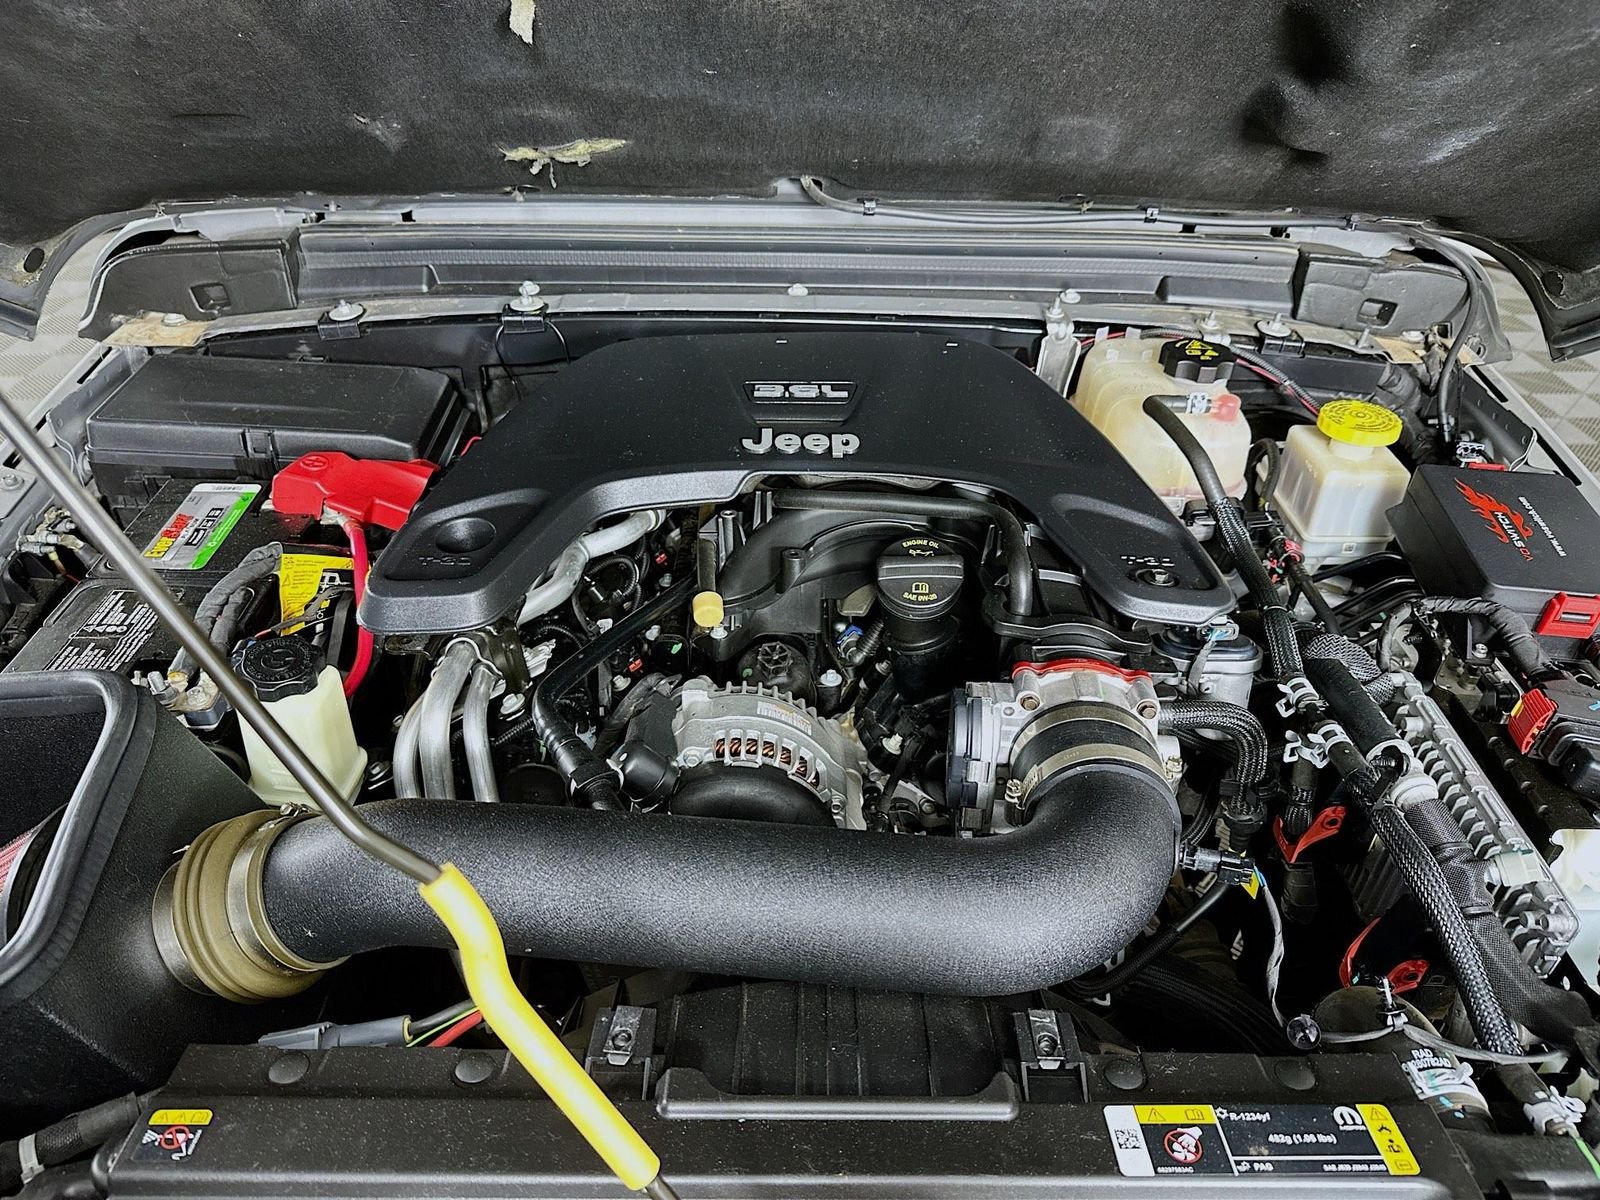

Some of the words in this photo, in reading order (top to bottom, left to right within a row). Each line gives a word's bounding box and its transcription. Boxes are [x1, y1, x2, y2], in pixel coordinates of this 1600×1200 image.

[753, 384, 849, 398] 3.6L
[741, 427, 860, 459] Jeep
[902, 539, 928, 548] ENGINE
[928, 540, 940, 549] OIL
[902, 591, 917, 601] SAE
[1411, 1048, 1434, 1061] RAD
